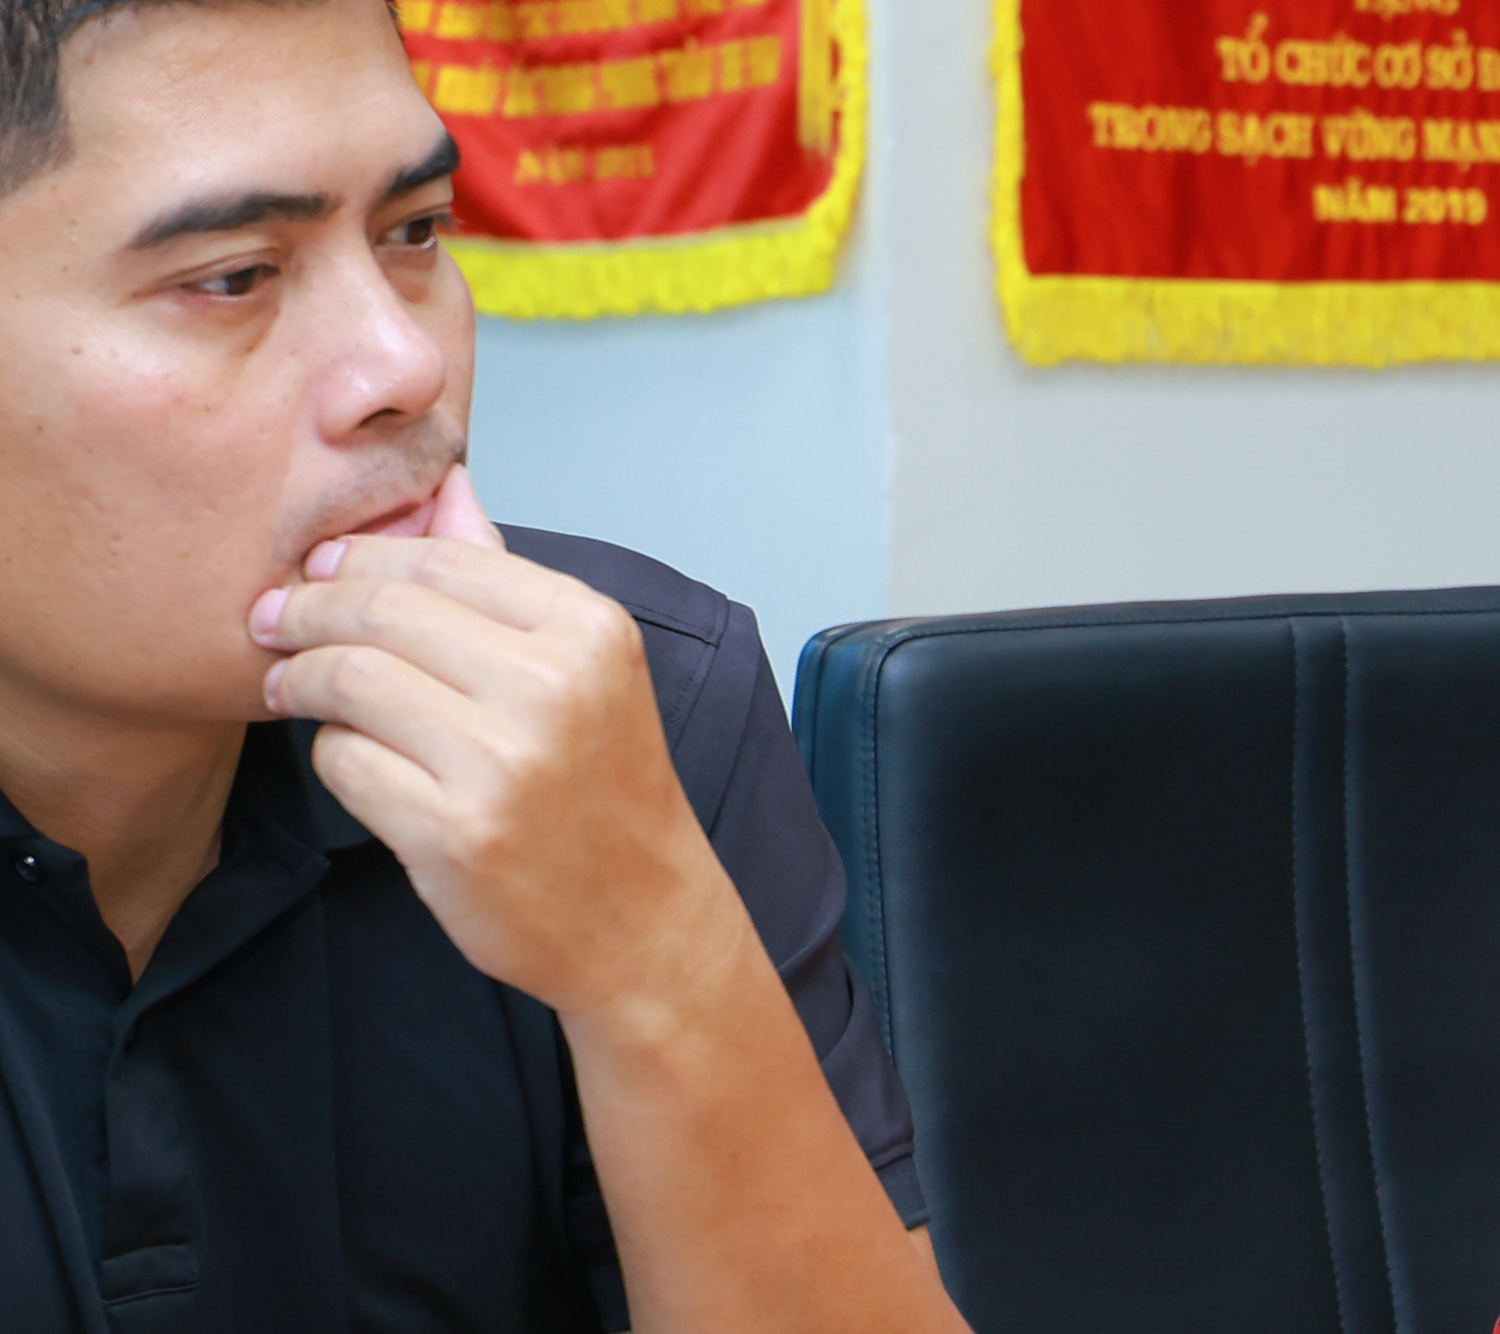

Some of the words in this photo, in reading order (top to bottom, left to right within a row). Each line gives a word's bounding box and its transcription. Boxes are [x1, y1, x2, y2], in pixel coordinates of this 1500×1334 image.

[1215, 13, 1270, 84] TỔ
[1274, 31, 1372, 89] CHỨC
[1373, 39, 1422, 89] CƠ
[1424, 28, 1475, 90] SỞ
[1087, 101, 1213, 153] TRONG
[1215, 110, 1314, 166] SẠCH
[1321, 107, 1417, 160] VỮNG
[1311, 176, 1397, 223] NĂM
[1403, 187, 1487, 225] 2019
